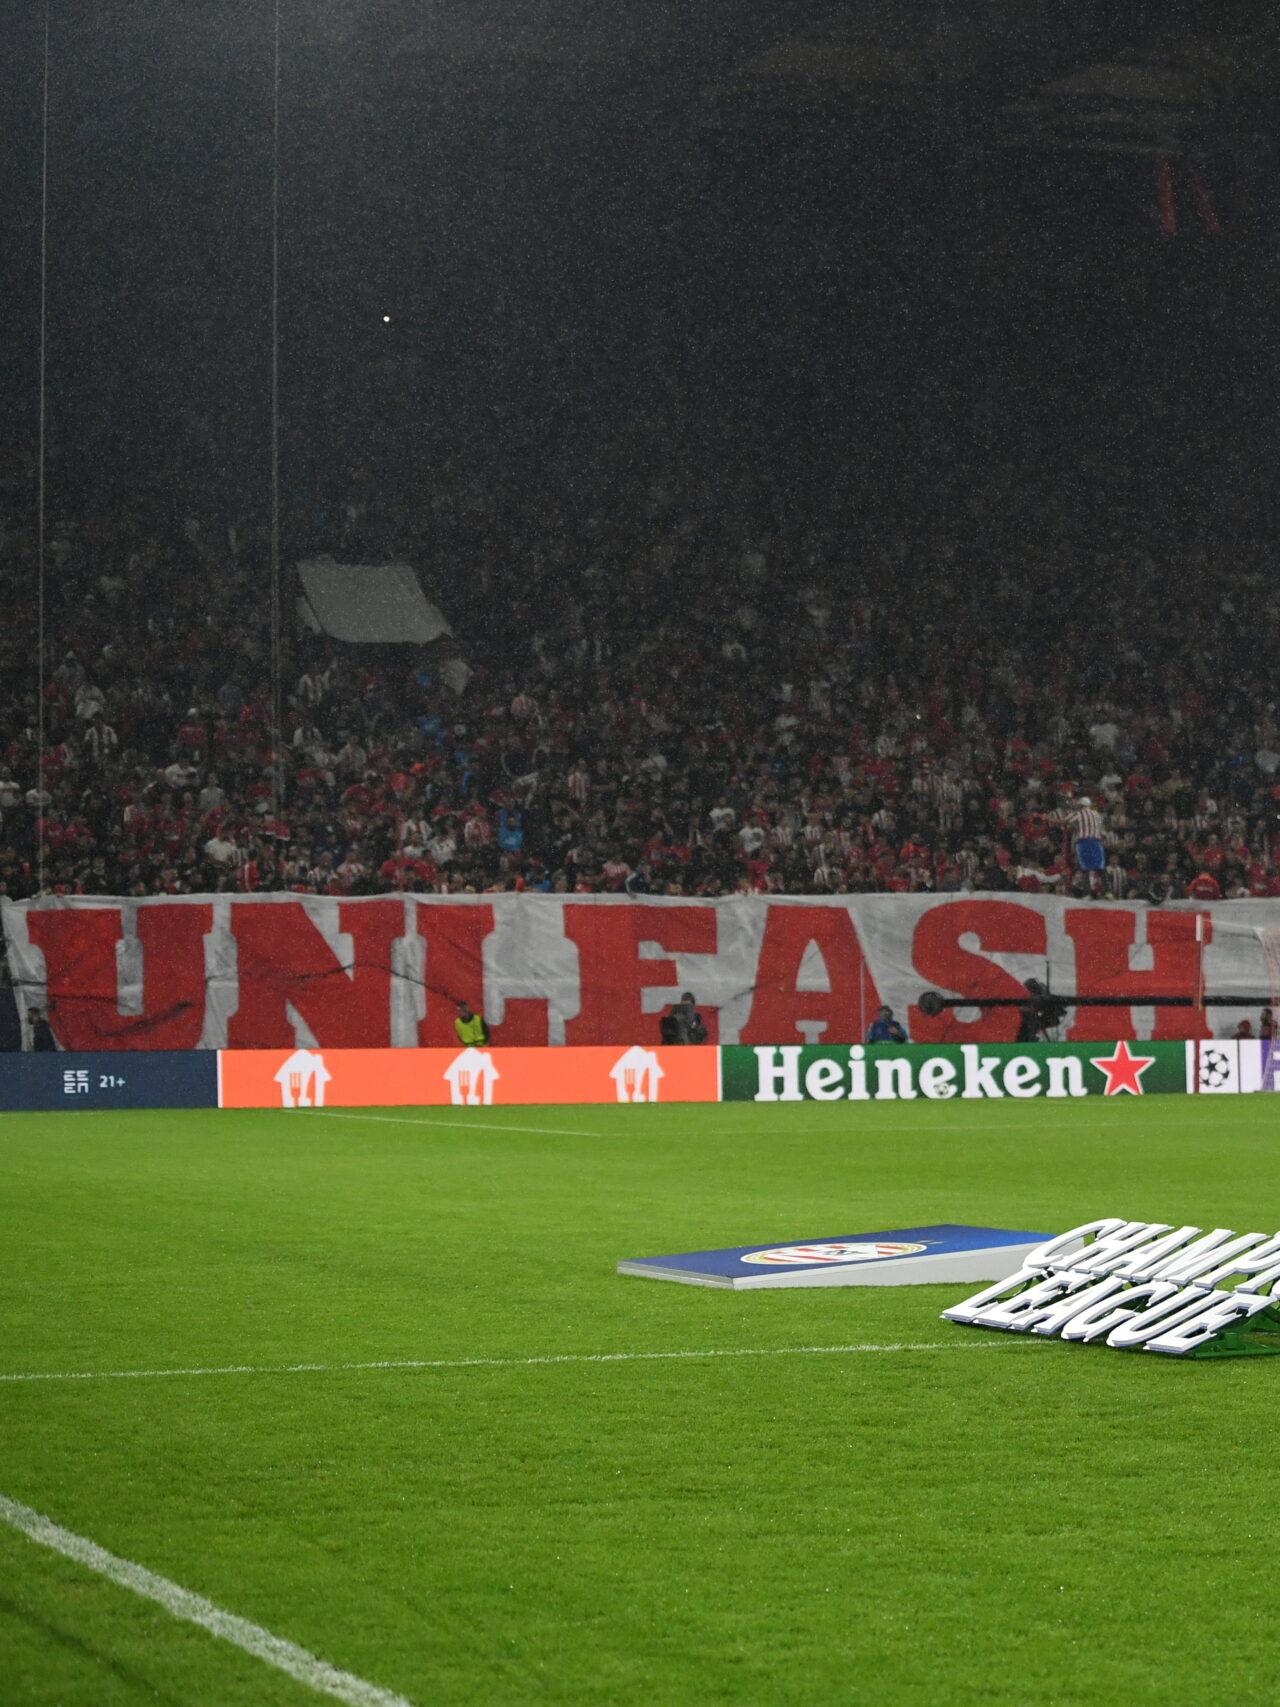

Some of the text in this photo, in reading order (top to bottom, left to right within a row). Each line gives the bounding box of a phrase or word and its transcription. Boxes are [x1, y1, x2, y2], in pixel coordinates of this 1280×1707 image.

[26, 899, 1213, 1048] UNLEASH
[99, 1075, 126, 1088] 21+
[753, 1045, 1088, 1100] Heineken
[939, 1270, 1276, 1354] LEAGUE
